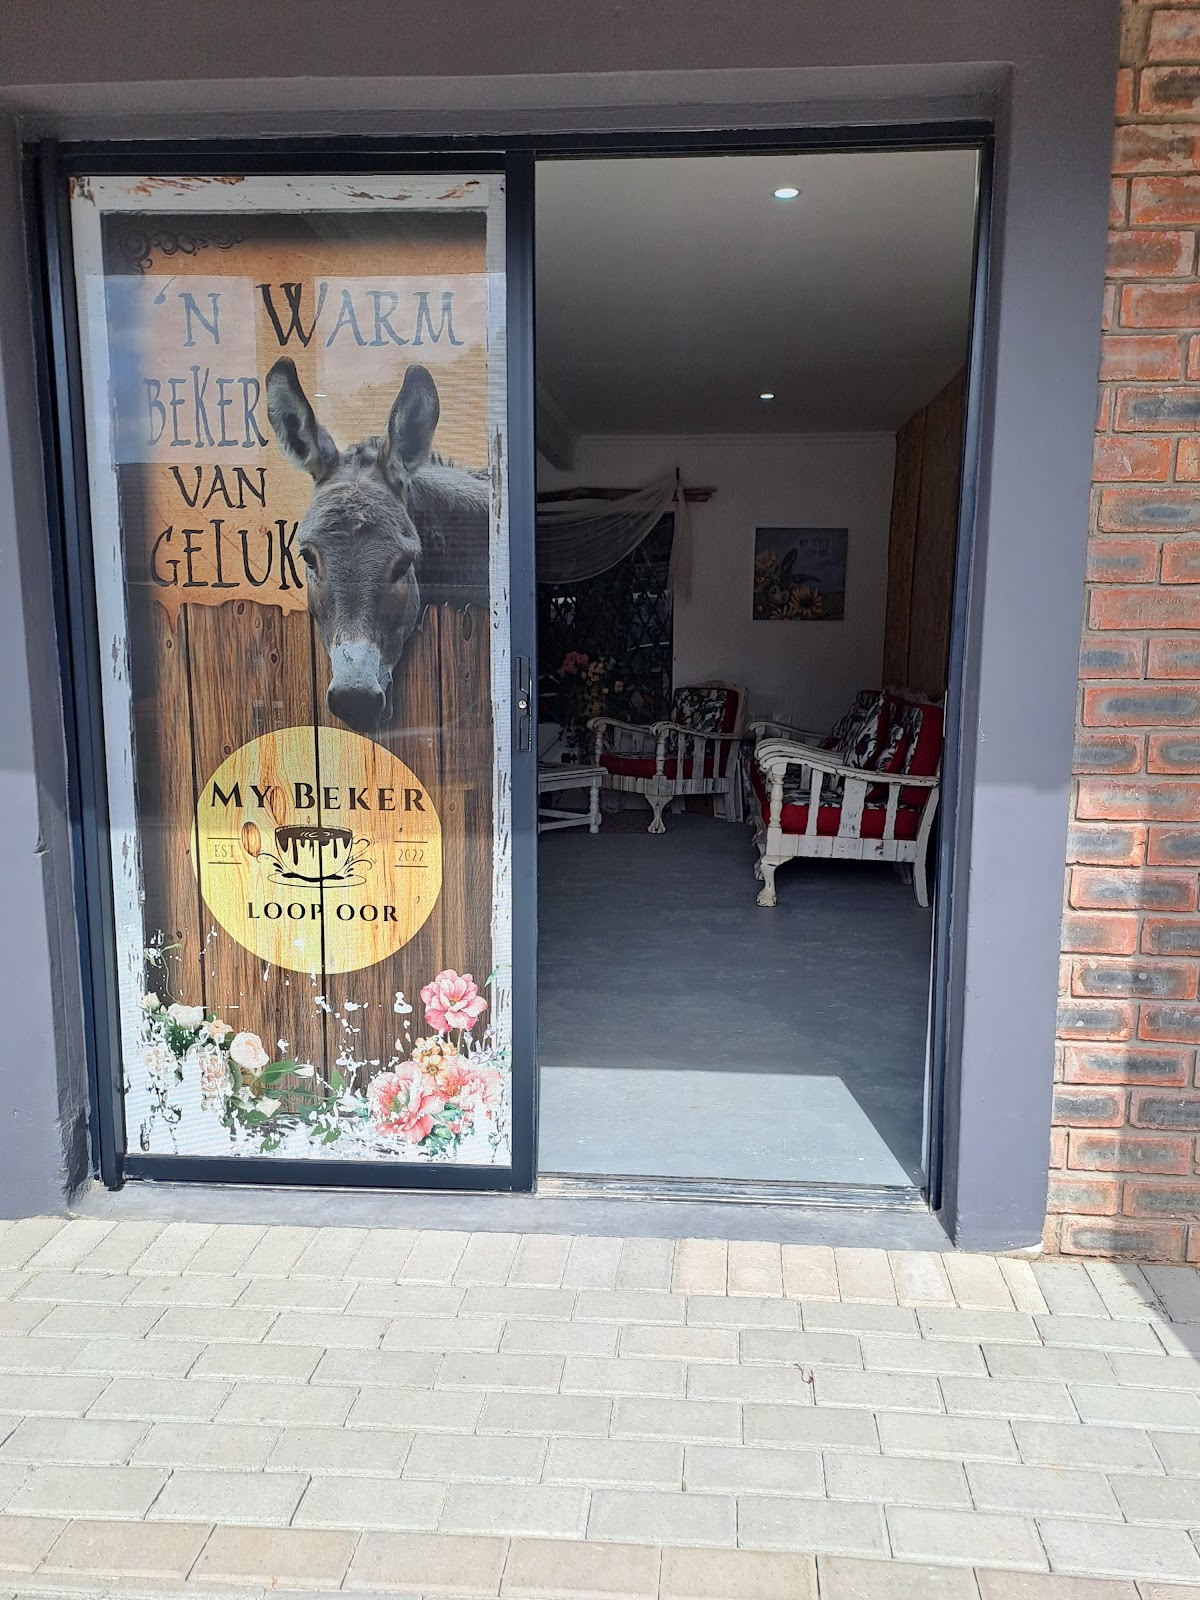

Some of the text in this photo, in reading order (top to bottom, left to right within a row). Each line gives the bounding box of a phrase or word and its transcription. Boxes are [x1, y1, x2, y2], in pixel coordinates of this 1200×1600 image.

[256, 281, 464, 348] WARM
[144, 365, 269, 449] BEKER
[168, 465, 267, 509] VAN
[150, 519, 304, 591] GELUK
[211, 782, 426, 812] MY BEKER
[398, 849, 425, 863] 2022
[248, 902, 398, 922] LOOP OOR
